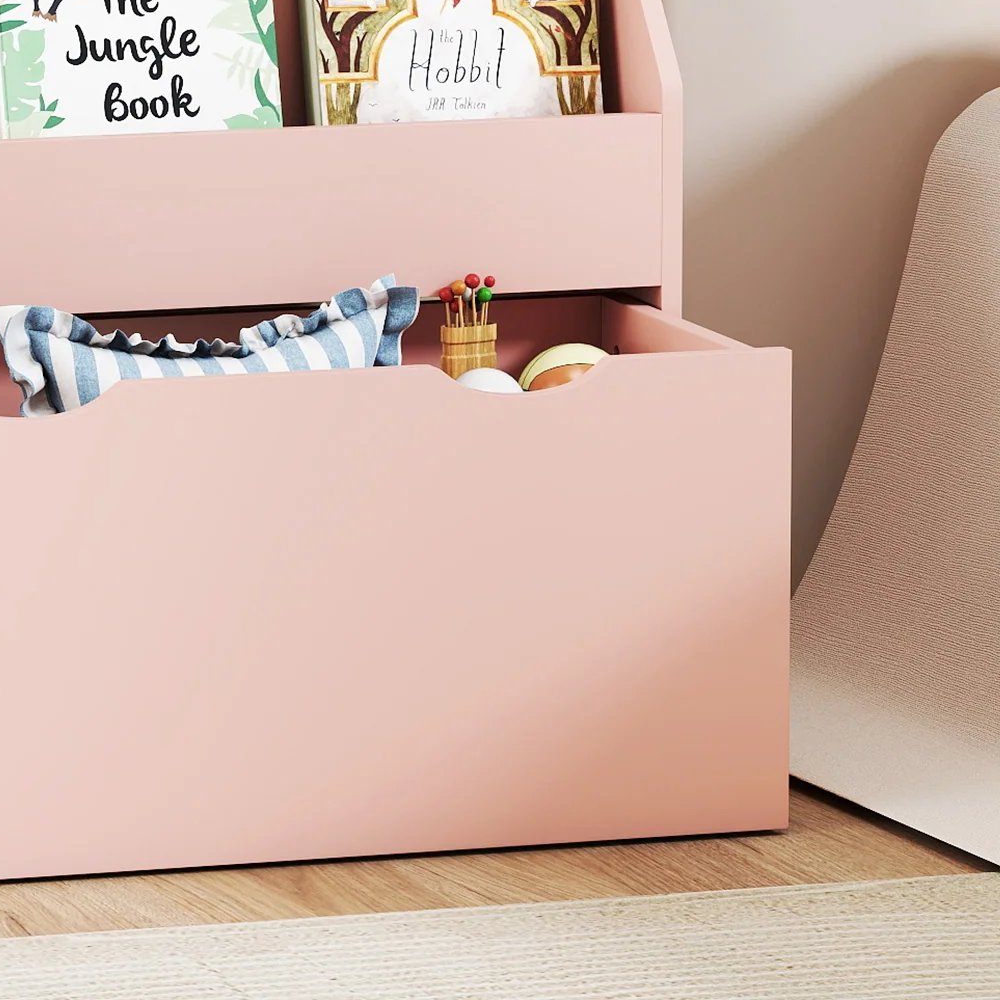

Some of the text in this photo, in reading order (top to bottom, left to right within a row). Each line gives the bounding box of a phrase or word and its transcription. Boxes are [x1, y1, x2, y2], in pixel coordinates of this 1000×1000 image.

[66, 15, 200, 80] Jungle
[439, 29, 454, 43] the
[408, 27, 506, 91] Hobbit
[452, 96, 487, 110] Tolkien
